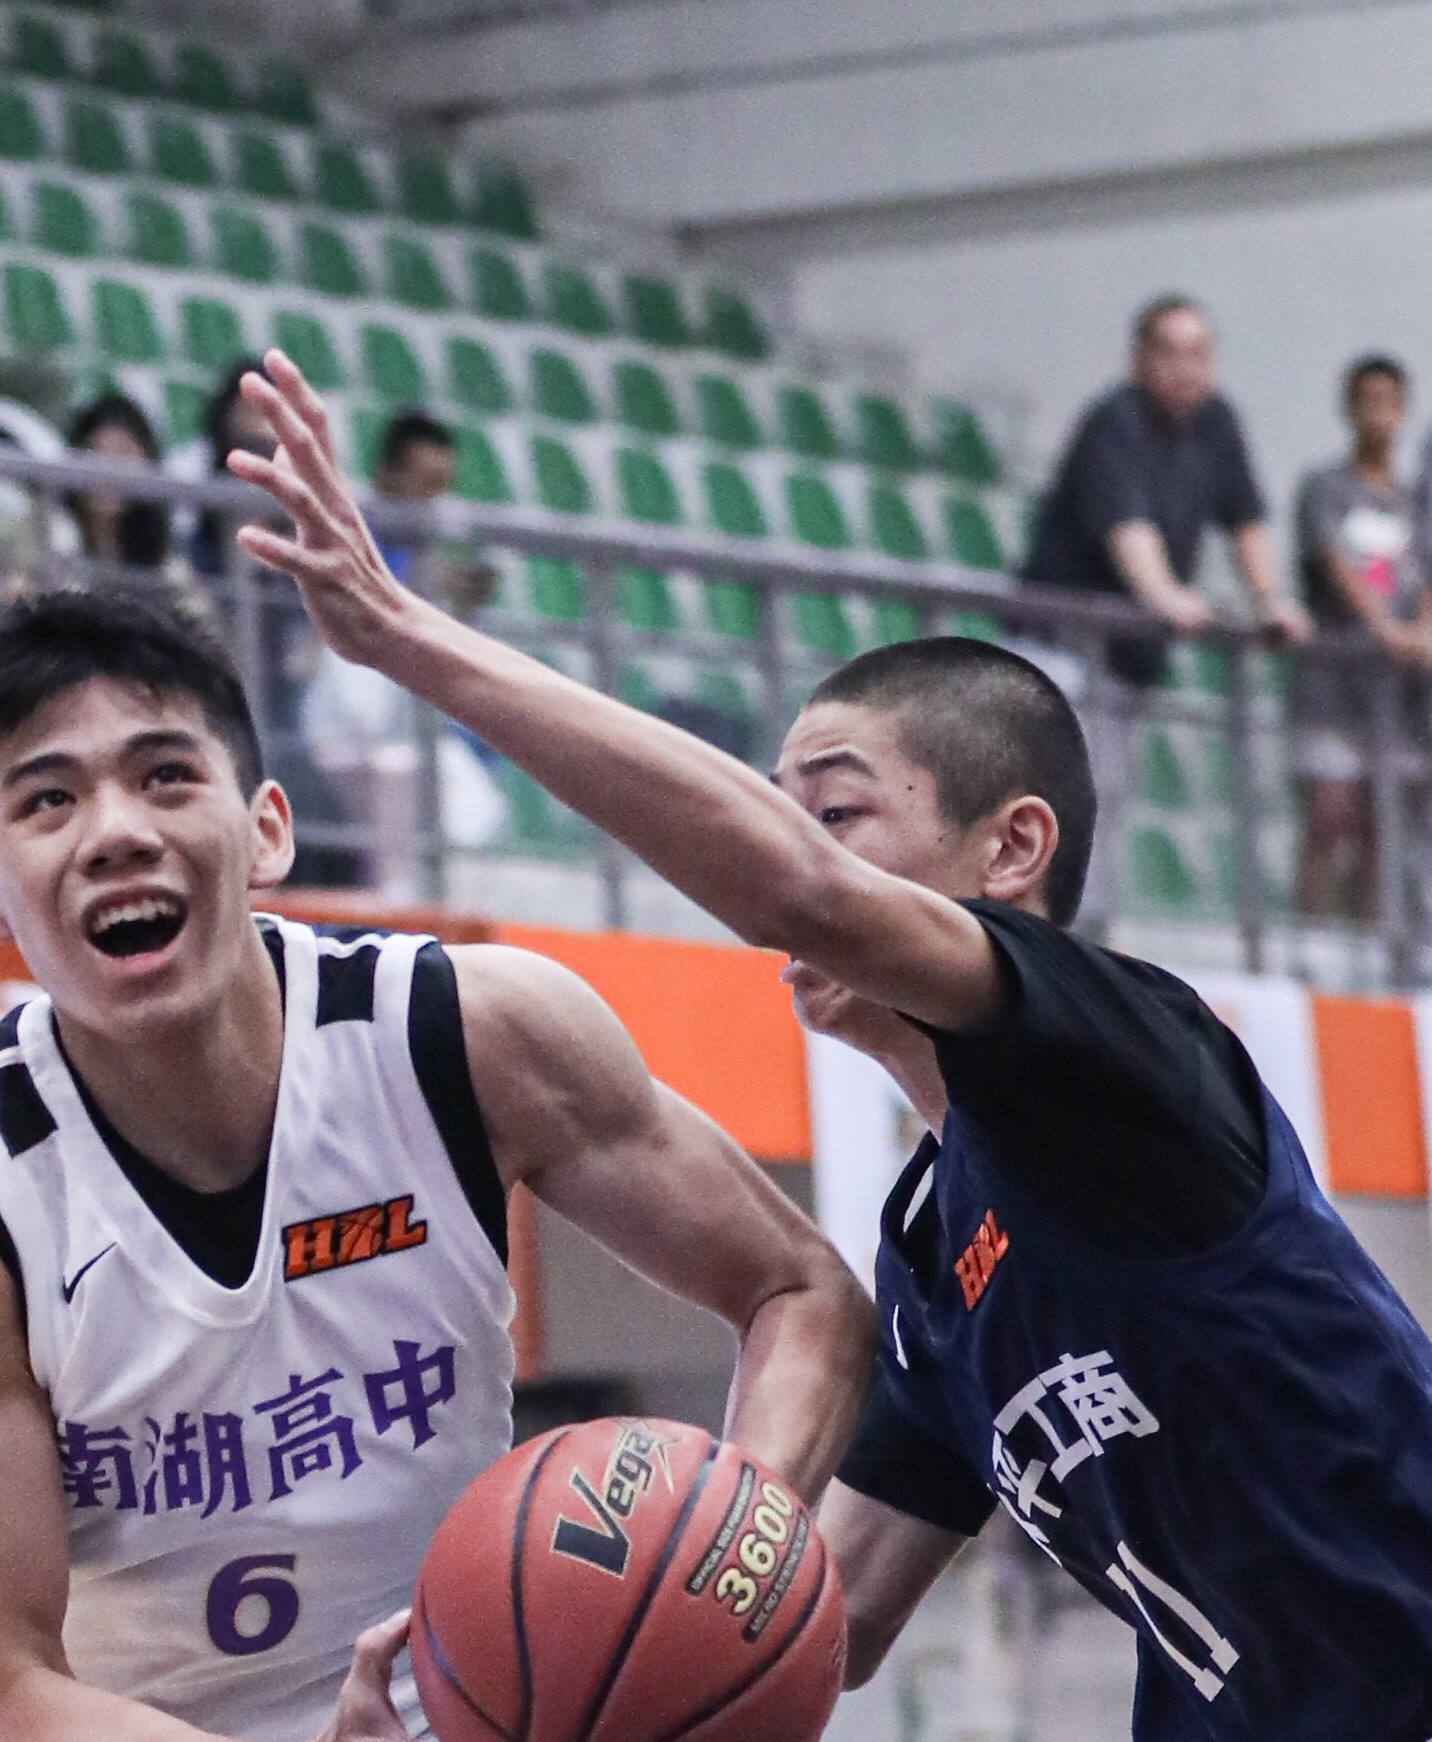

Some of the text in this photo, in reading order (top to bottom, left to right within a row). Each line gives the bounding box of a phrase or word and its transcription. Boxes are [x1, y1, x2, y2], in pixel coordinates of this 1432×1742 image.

[282, 1194, 428, 1283] HBL
[58, 1339, 457, 1519] 南湖高中
[986, 1348, 1161, 1568] 平工商
[205, 1552, 301, 1657] 6
[716, 1481, 794, 1615] 3600
